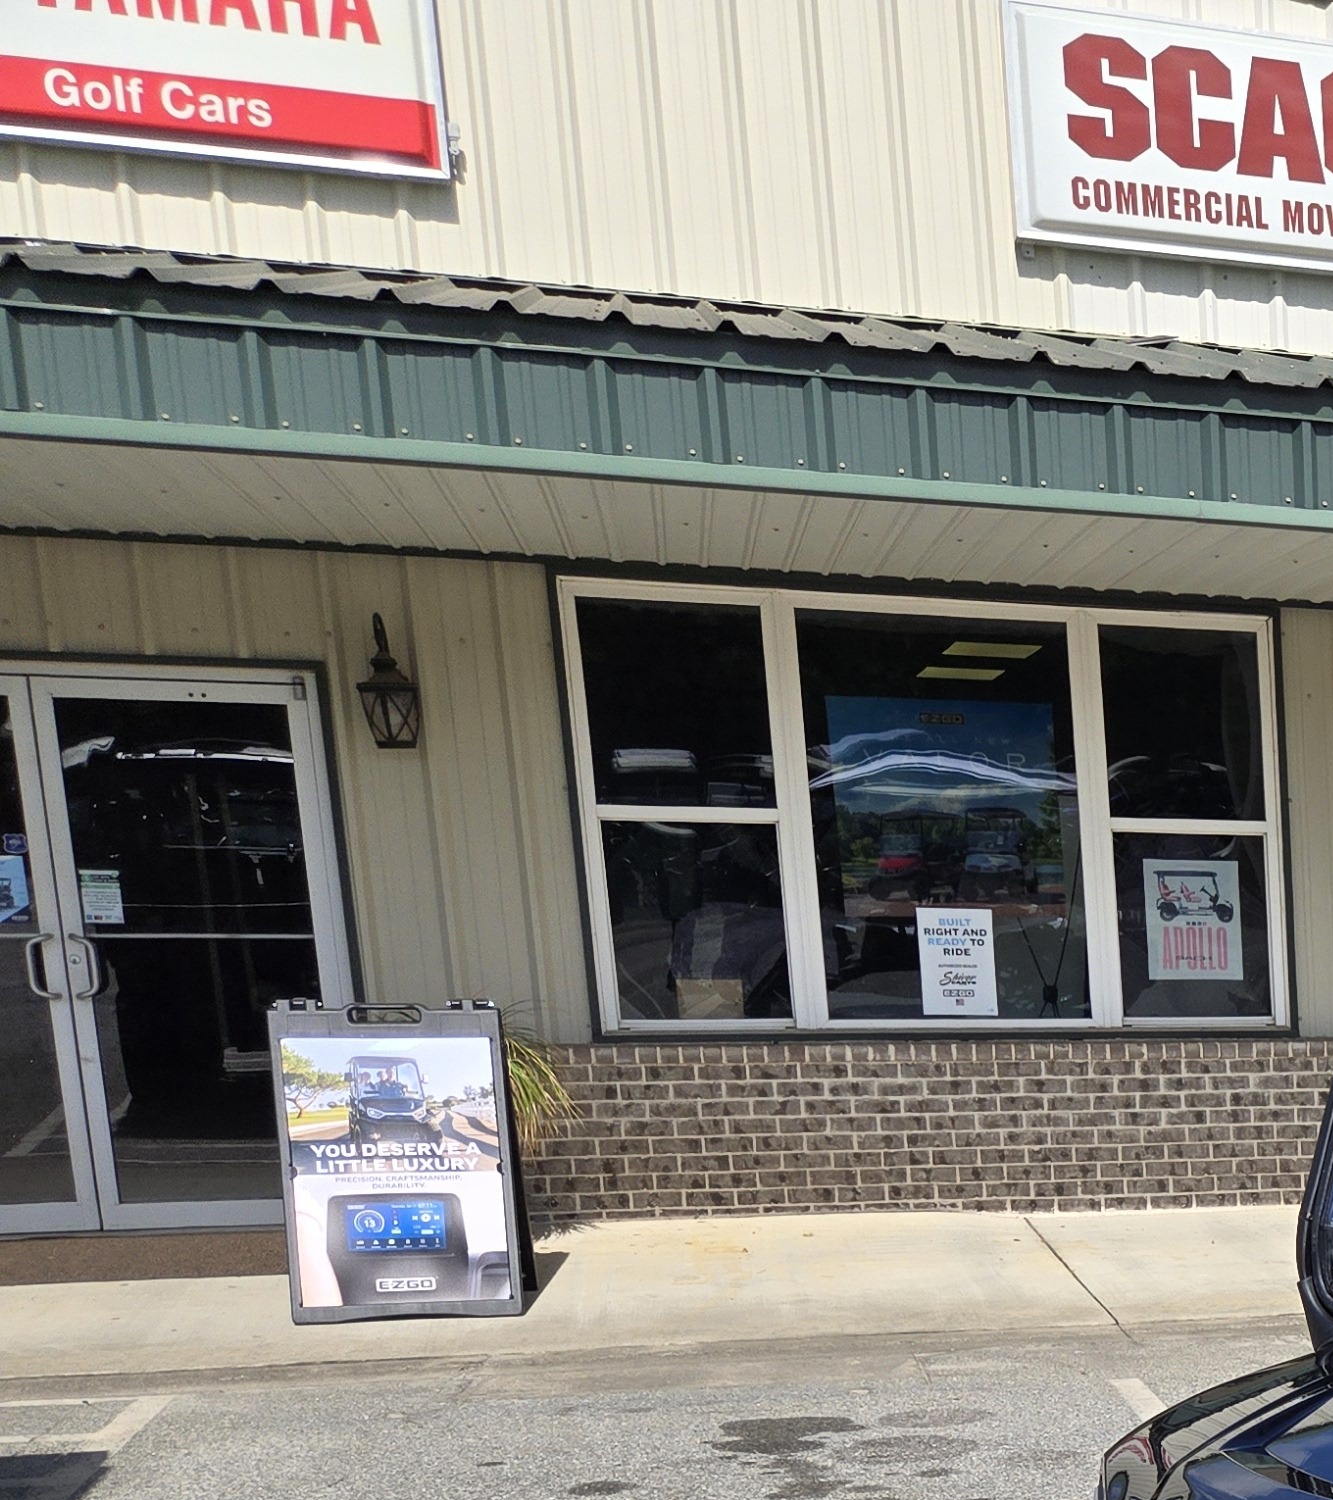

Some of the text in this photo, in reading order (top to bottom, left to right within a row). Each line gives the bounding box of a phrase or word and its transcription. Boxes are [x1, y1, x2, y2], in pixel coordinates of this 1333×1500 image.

[42, 68, 273, 128] Golf Cars
[1071, 175, 1269, 230] COMMERCIAL
[938, 918, 972, 927] BUILT
[923, 927, 987, 937] RIGHT AND
[928, 938, 985, 947] READY TO
[1163, 926, 1228, 971] APOLLO
[943, 948, 971, 956] RIDE
[310, 1141, 482, 1158] YOU DESERVE A
[315, 1157, 479, 1174] LITTLE LUXURY
[378, 1279, 434, 1290] EZGO
